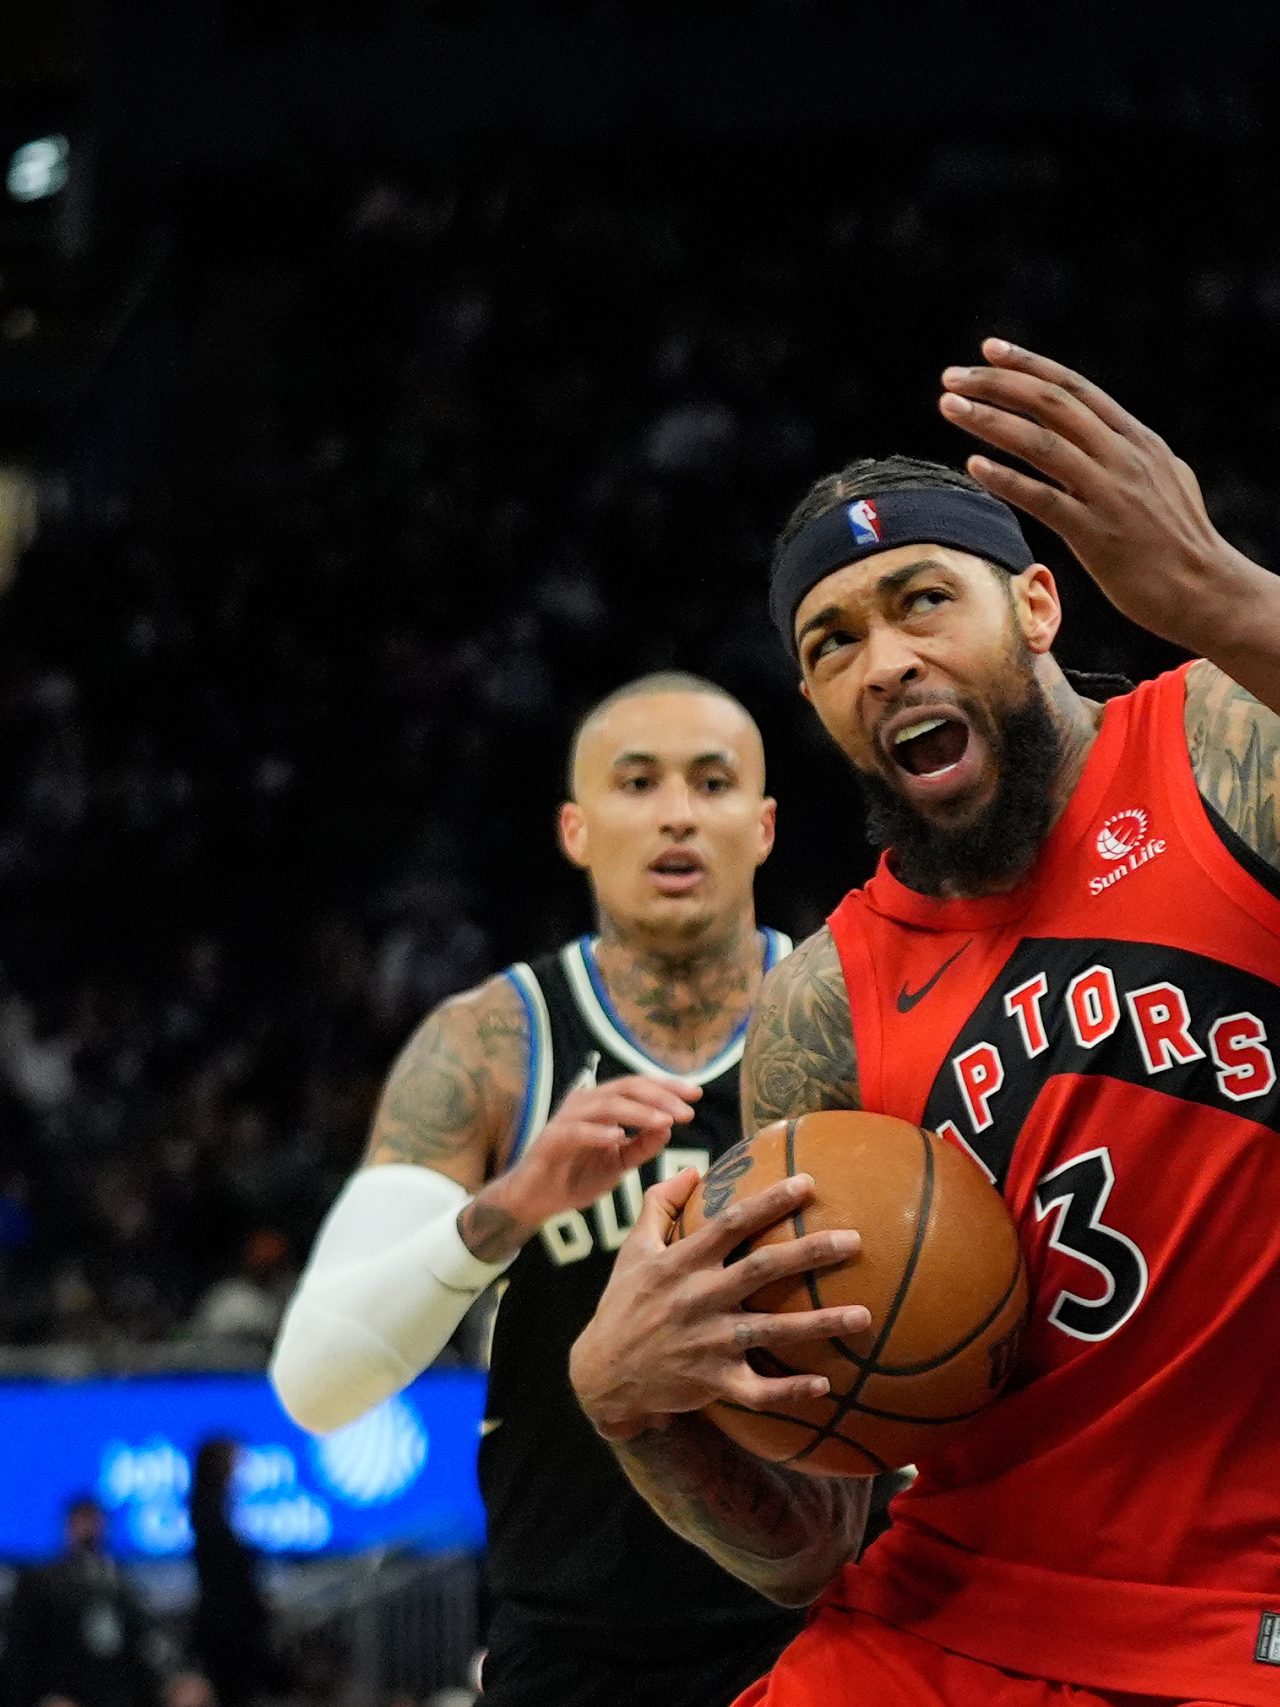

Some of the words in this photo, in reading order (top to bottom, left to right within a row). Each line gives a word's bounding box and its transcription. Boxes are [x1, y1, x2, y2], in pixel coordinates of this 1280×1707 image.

[1089, 865, 1128, 896] Sun
[1129, 839, 1167, 871] Life
[1035, 1147, 1148, 1341] 3
